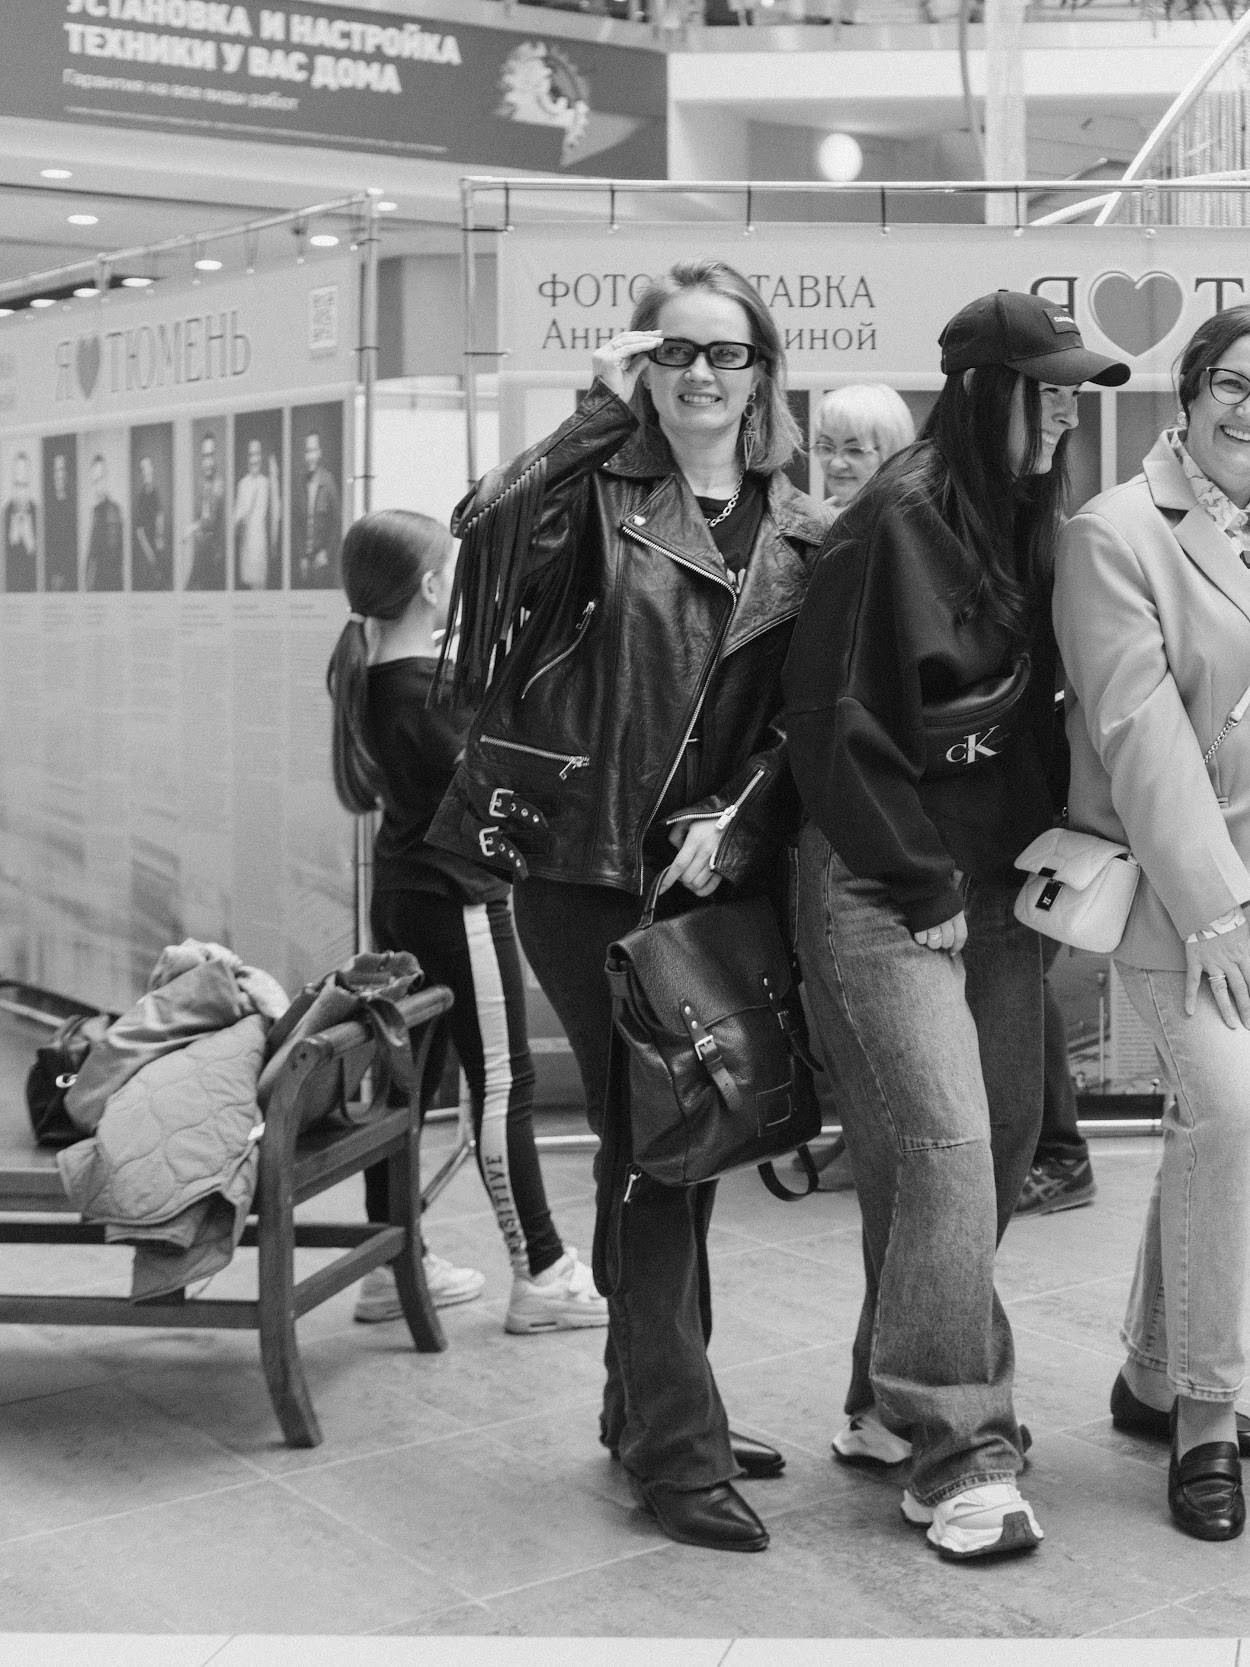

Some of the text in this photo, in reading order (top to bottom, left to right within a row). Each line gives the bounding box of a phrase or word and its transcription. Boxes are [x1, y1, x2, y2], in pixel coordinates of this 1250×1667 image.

[63, 22, 403, 94] ТЕХНИКИ У ВАС ДОМА
[259, 9, 287, 42] И
[289, 13, 463, 66] НАСТРОЙКА
[104, 309, 253, 394] ТЮМЕНЬ
[542, 318, 628, 350] Анн
